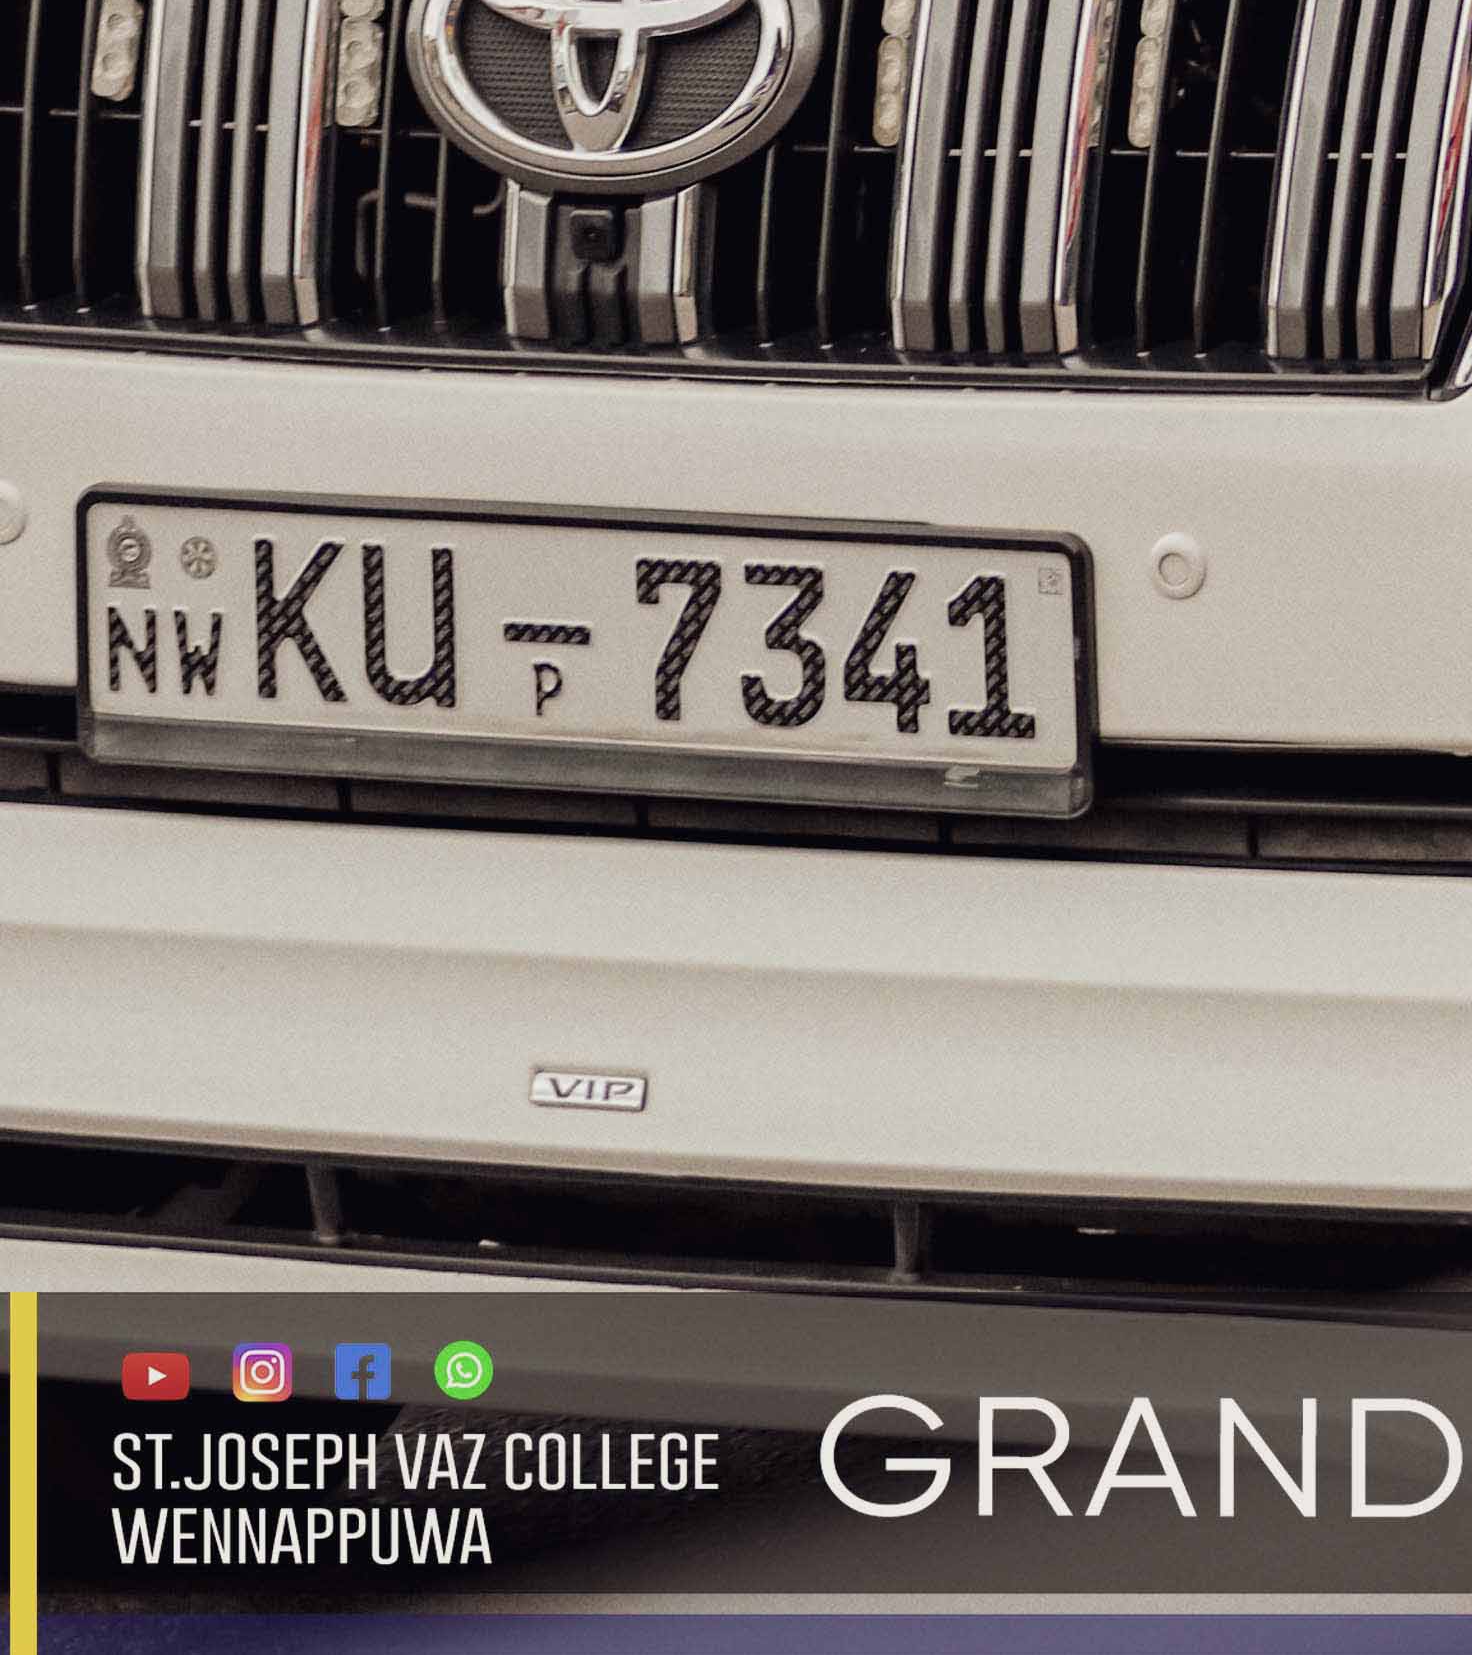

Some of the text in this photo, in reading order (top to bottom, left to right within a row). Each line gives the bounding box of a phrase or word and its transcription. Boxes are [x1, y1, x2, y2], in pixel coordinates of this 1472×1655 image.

[107, 606, 222, 697] NW
[254, 538, 457, 709] KU
[635, 557, 1037, 740] 7341
[548, 1077, 635, 1101] VIP
